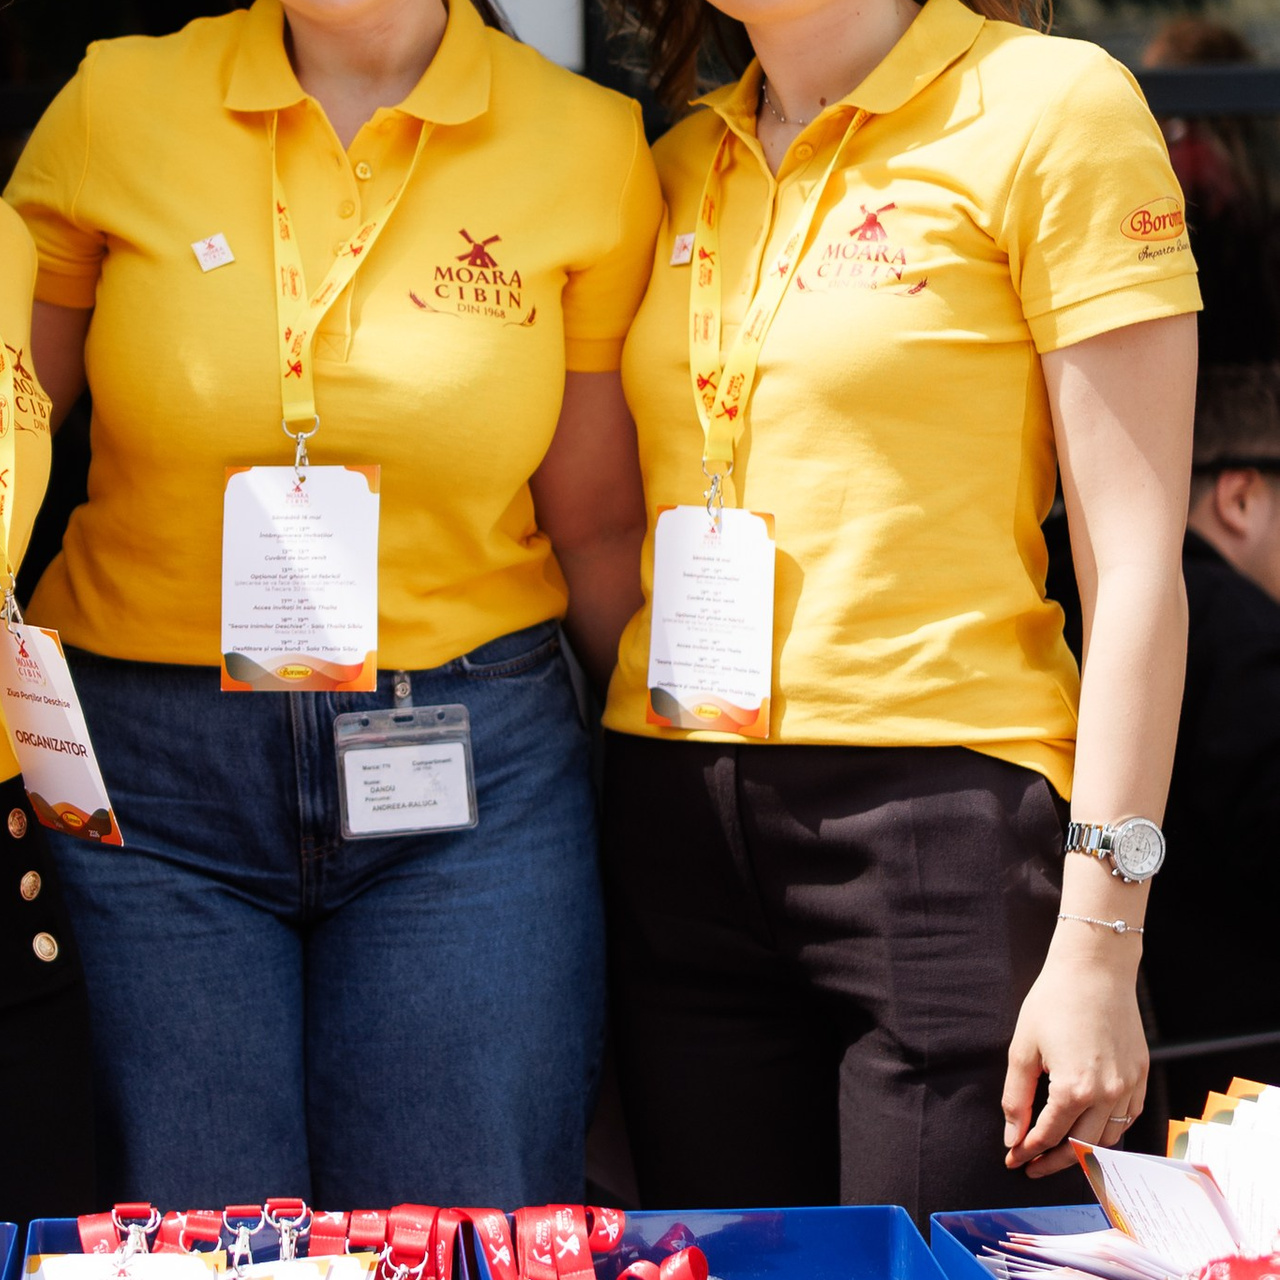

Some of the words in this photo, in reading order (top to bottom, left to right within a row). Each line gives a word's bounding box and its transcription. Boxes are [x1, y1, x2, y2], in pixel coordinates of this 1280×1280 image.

[822, 243, 907, 265] MOARA
[434, 266, 523, 289] MOARA
[817, 262, 903, 281] CIBIN
[435, 284, 521, 309] CIBIN
[457, 302, 480, 315] DIN
[483, 305, 506, 320] 1968
[16, 396, 51, 419] CIBI
[15, 656, 39, 670] MOARA
[18, 667, 42, 679] CIBIN
[43, 696, 70, 708] Deschise
[15, 729, 88, 758] ORGANIZATOR
